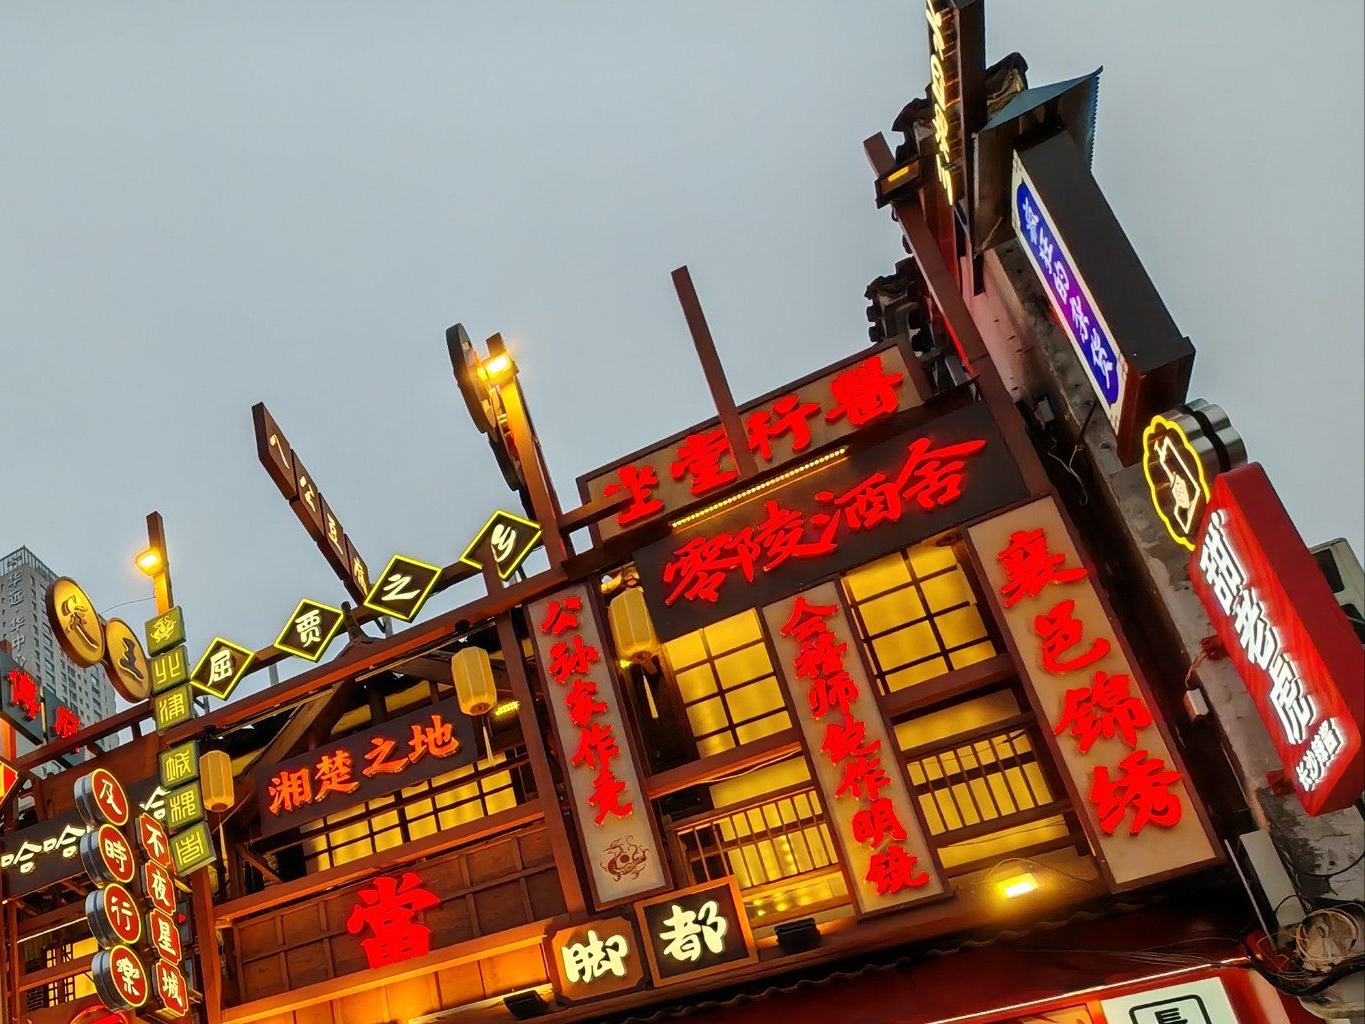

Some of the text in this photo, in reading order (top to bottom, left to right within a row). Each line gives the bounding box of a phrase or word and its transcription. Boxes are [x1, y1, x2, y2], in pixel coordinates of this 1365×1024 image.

[1199, 510, 1318, 745] 甜老虎
[268, 714, 460, 817] 湘楚之地
[147, 828, 185, 1008] 不夜星城
